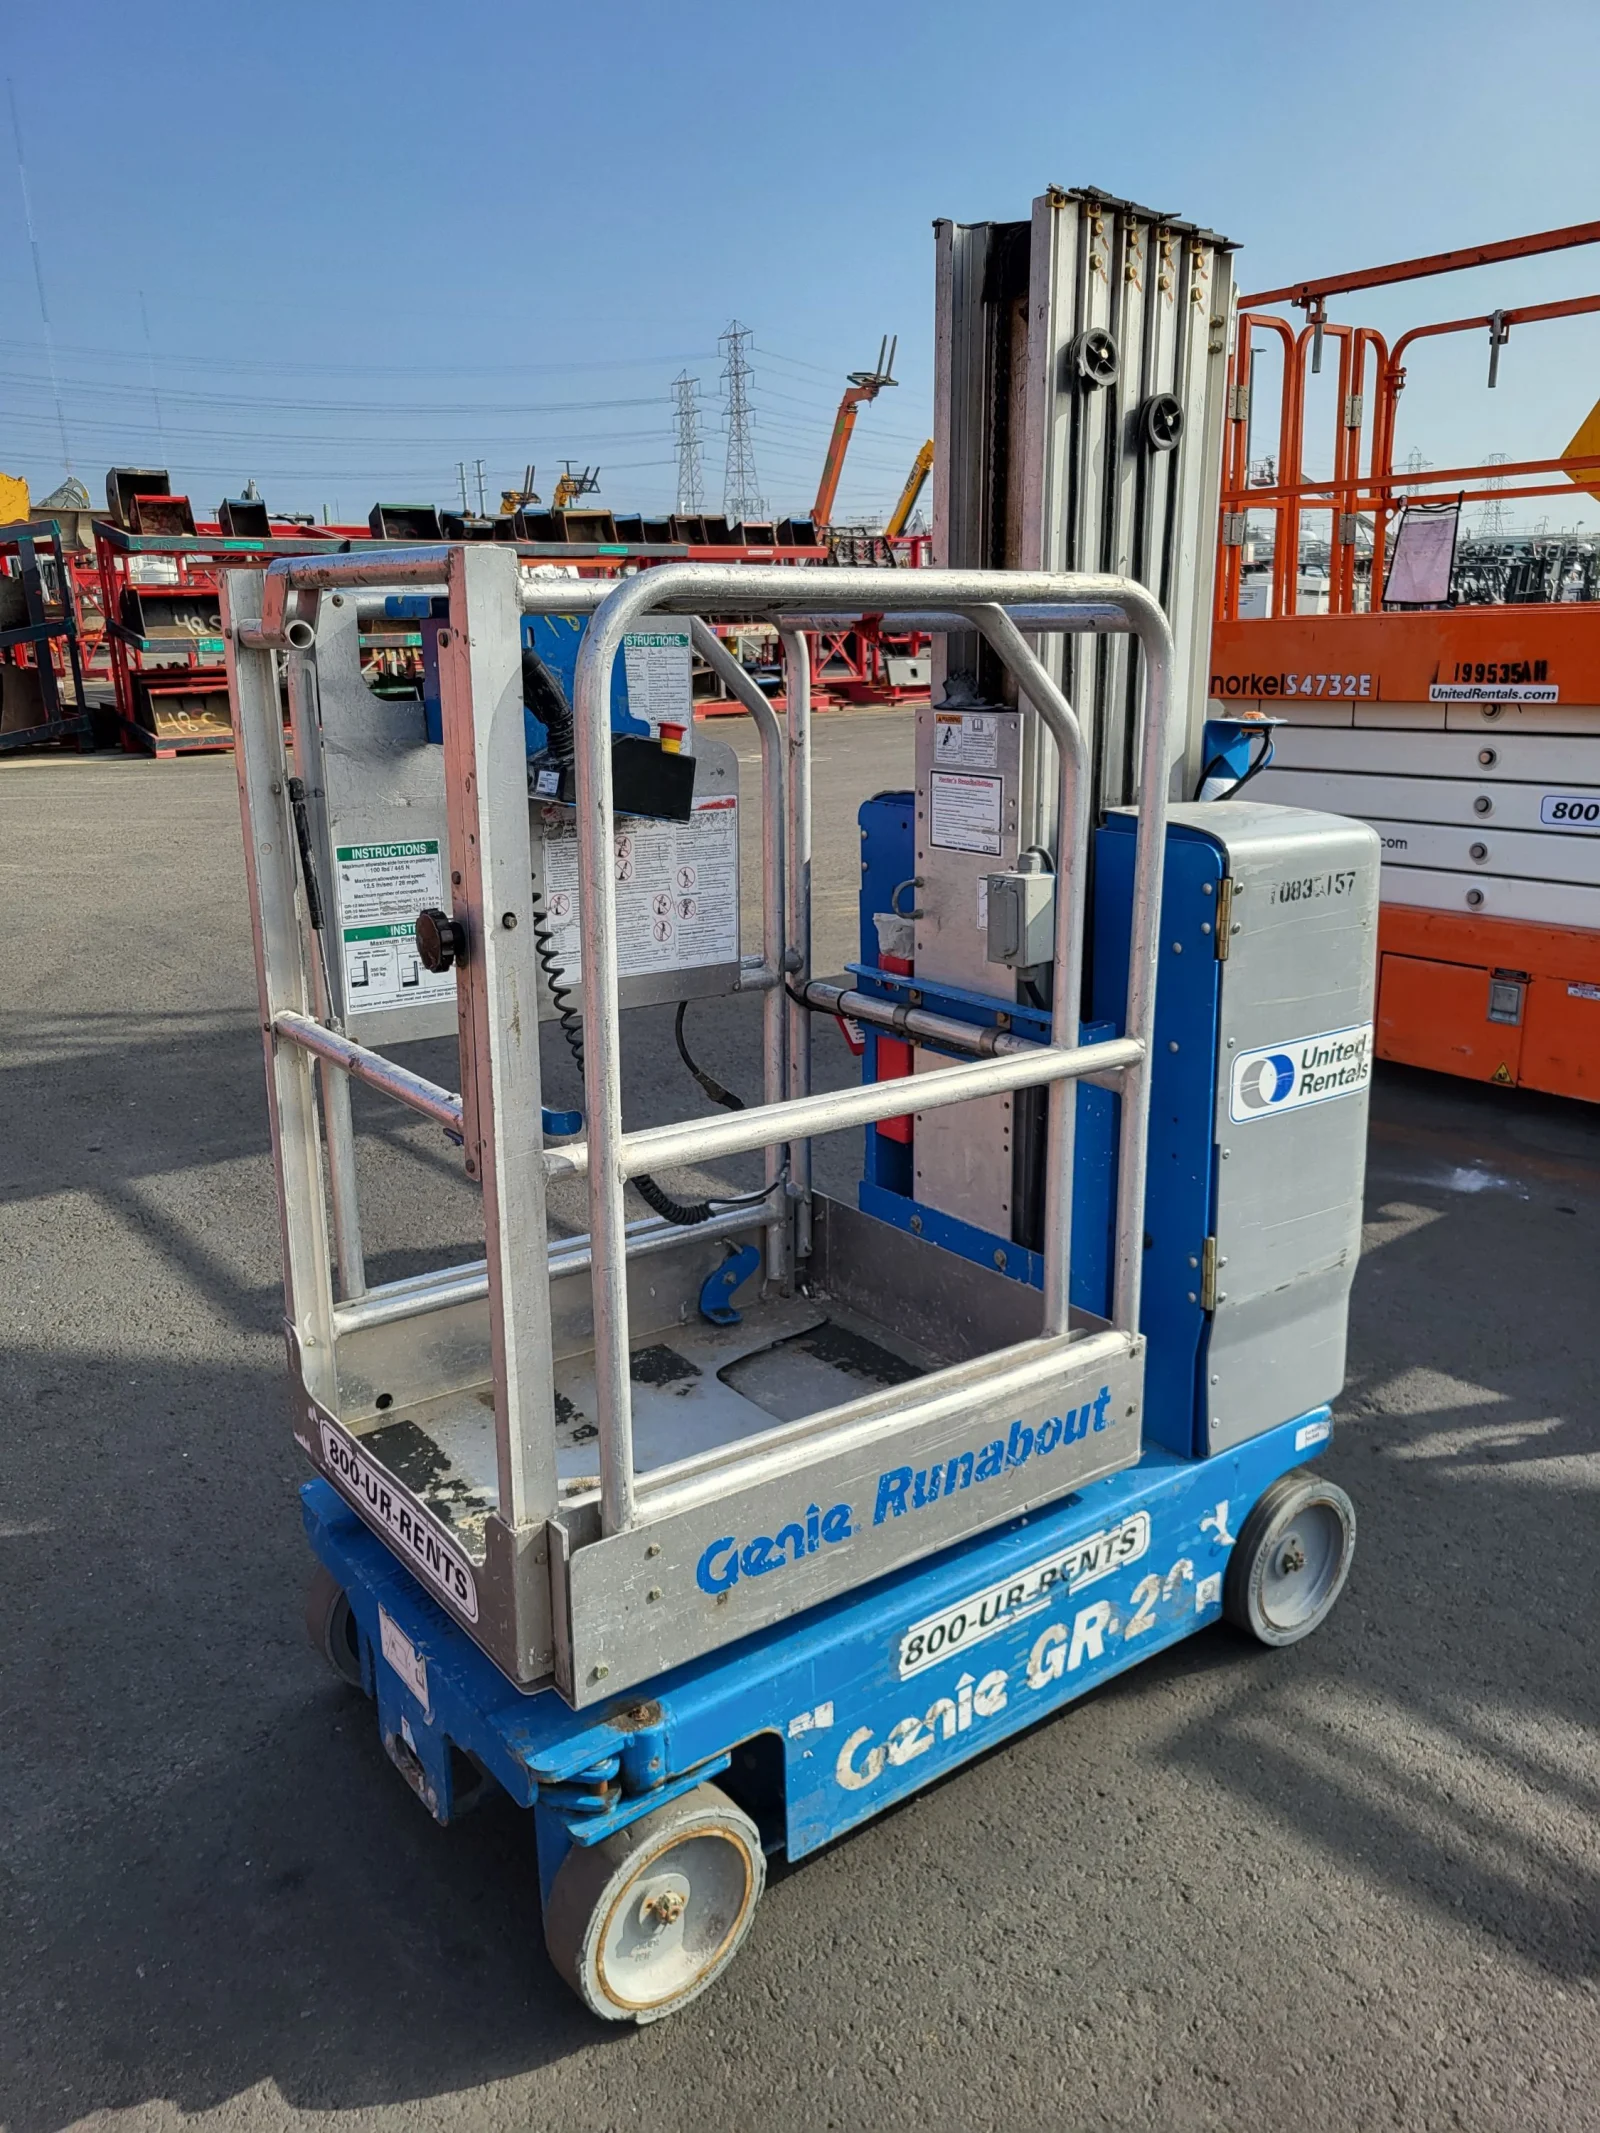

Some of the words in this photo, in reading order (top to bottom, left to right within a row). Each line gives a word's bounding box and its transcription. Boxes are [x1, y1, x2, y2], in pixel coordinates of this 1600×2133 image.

[623, 635, 680, 646] STRUCTIONS
[1210, 673, 1285, 696] norkel
[1286, 673, 1371, 696] S4732E
[1431, 687, 1557, 701] UnitedRentals.com
[1552, 802, 1600, 821] 800
[352, 843, 427, 859] INSTRUCTIONS
[1301, 1034, 1367, 1070] United
[1298, 1062, 1368, 1096] Rentals
[696, 1502, 853, 1595] Genie
[872, 1385, 1112, 1527] Runabout
[329, 1438, 468, 1601] 800-UR-RENTS
[835, 1669, 1010, 1791] Genie
